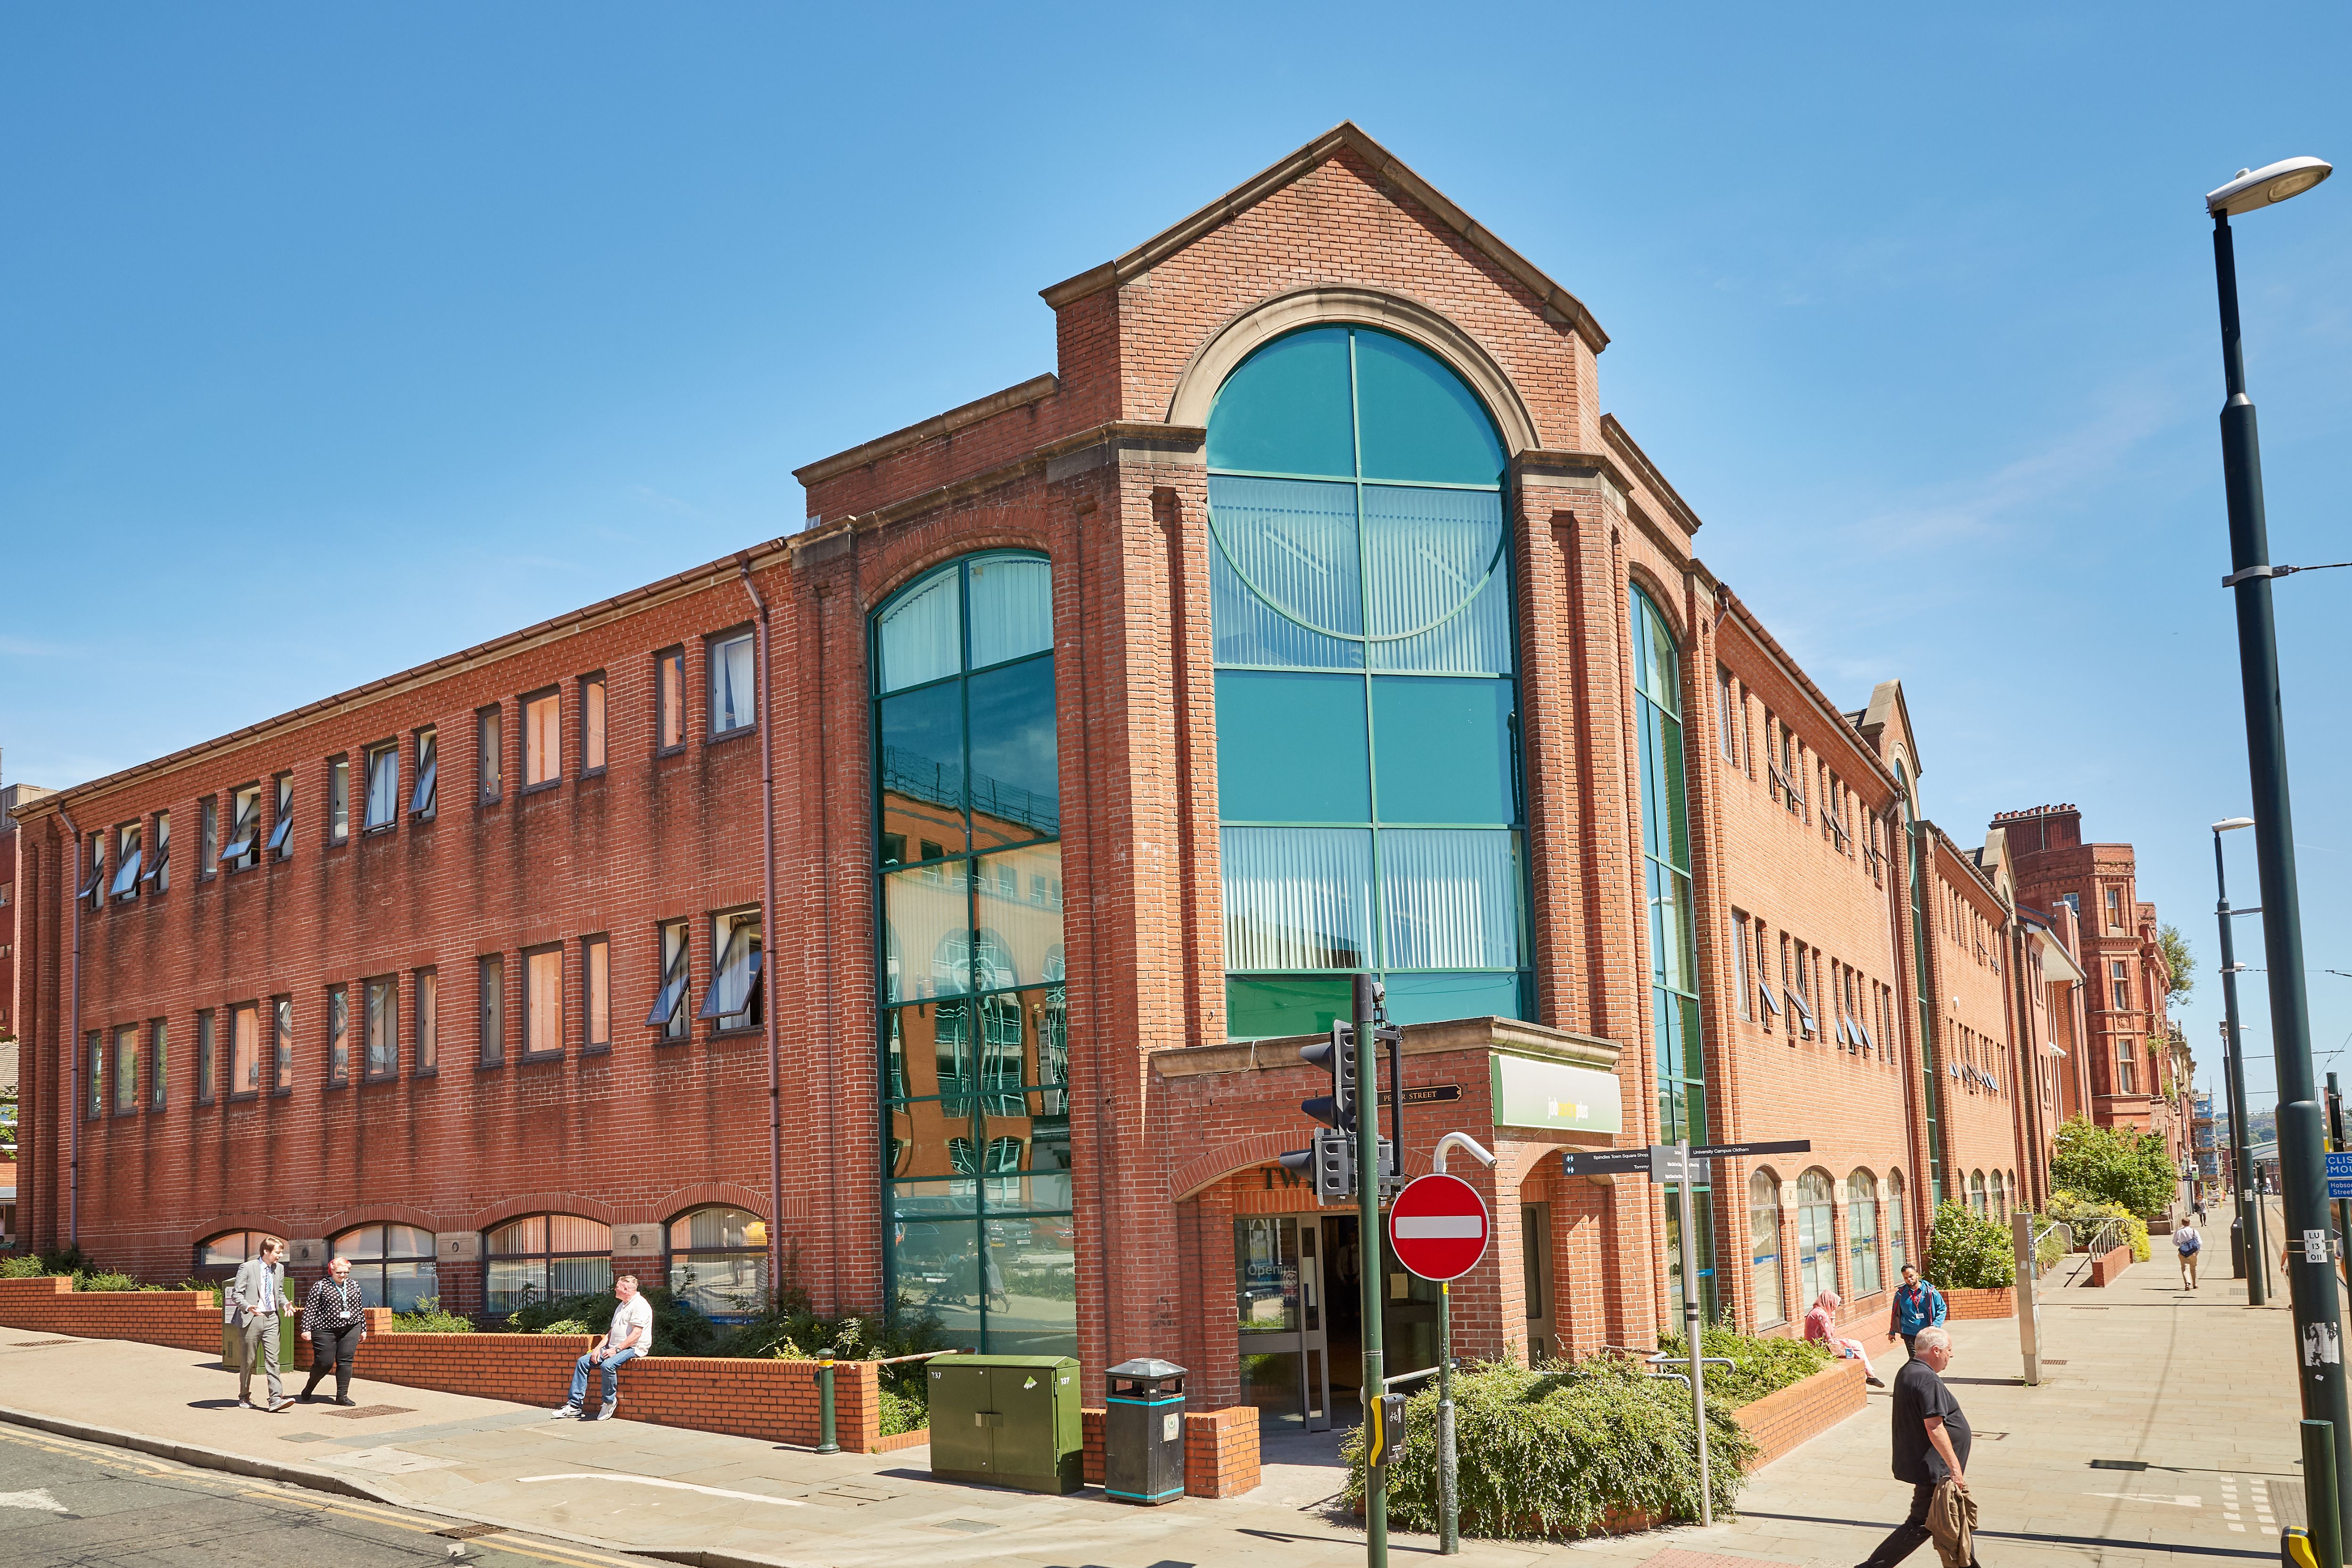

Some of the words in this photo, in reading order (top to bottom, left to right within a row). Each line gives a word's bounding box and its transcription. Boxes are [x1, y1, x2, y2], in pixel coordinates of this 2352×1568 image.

[1384, 1092, 1406, 1101] PER
[1409, 1091, 1437, 1099] STREET
[2325, 1156, 2352, 1164] CLIS
[1060, 1377, 1070, 1385] 137
